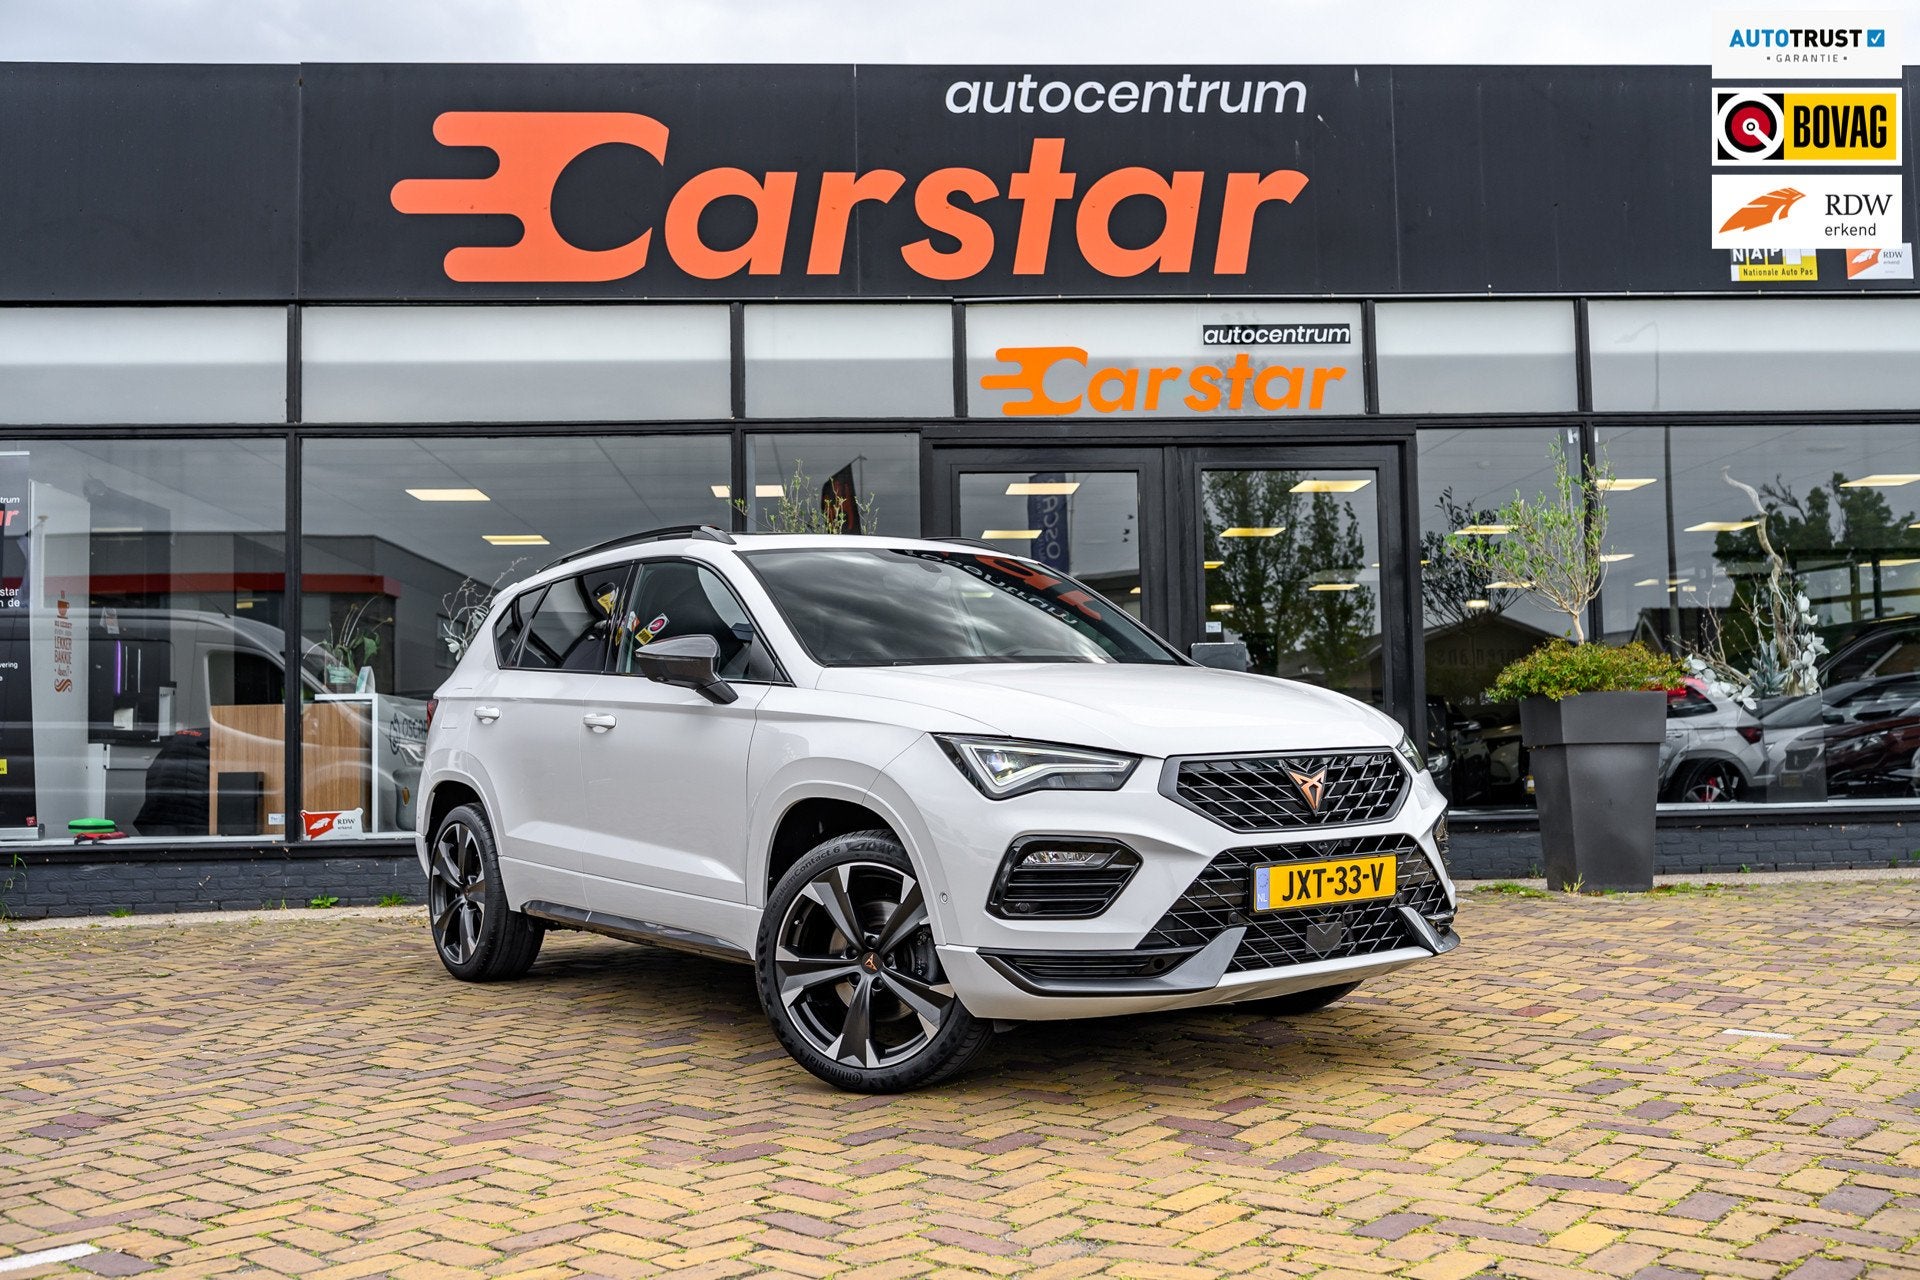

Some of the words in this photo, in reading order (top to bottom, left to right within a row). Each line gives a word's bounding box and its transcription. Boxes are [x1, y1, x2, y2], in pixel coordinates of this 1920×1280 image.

[945, 74, 1309, 114] autocentrum
[391, 111, 1309, 282] Carstar
[1782, 268, 1798, 276] Auto
[1801, 268, 1813, 276] Pas
[1204, 325, 1350, 344] autocentrum
[980, 347, 1346, 416] Carstar
[8, 598, 20, 607] de
[1282, 863, 1385, 901] JXT-33-V
[1257, 893, 1268, 902] NL
